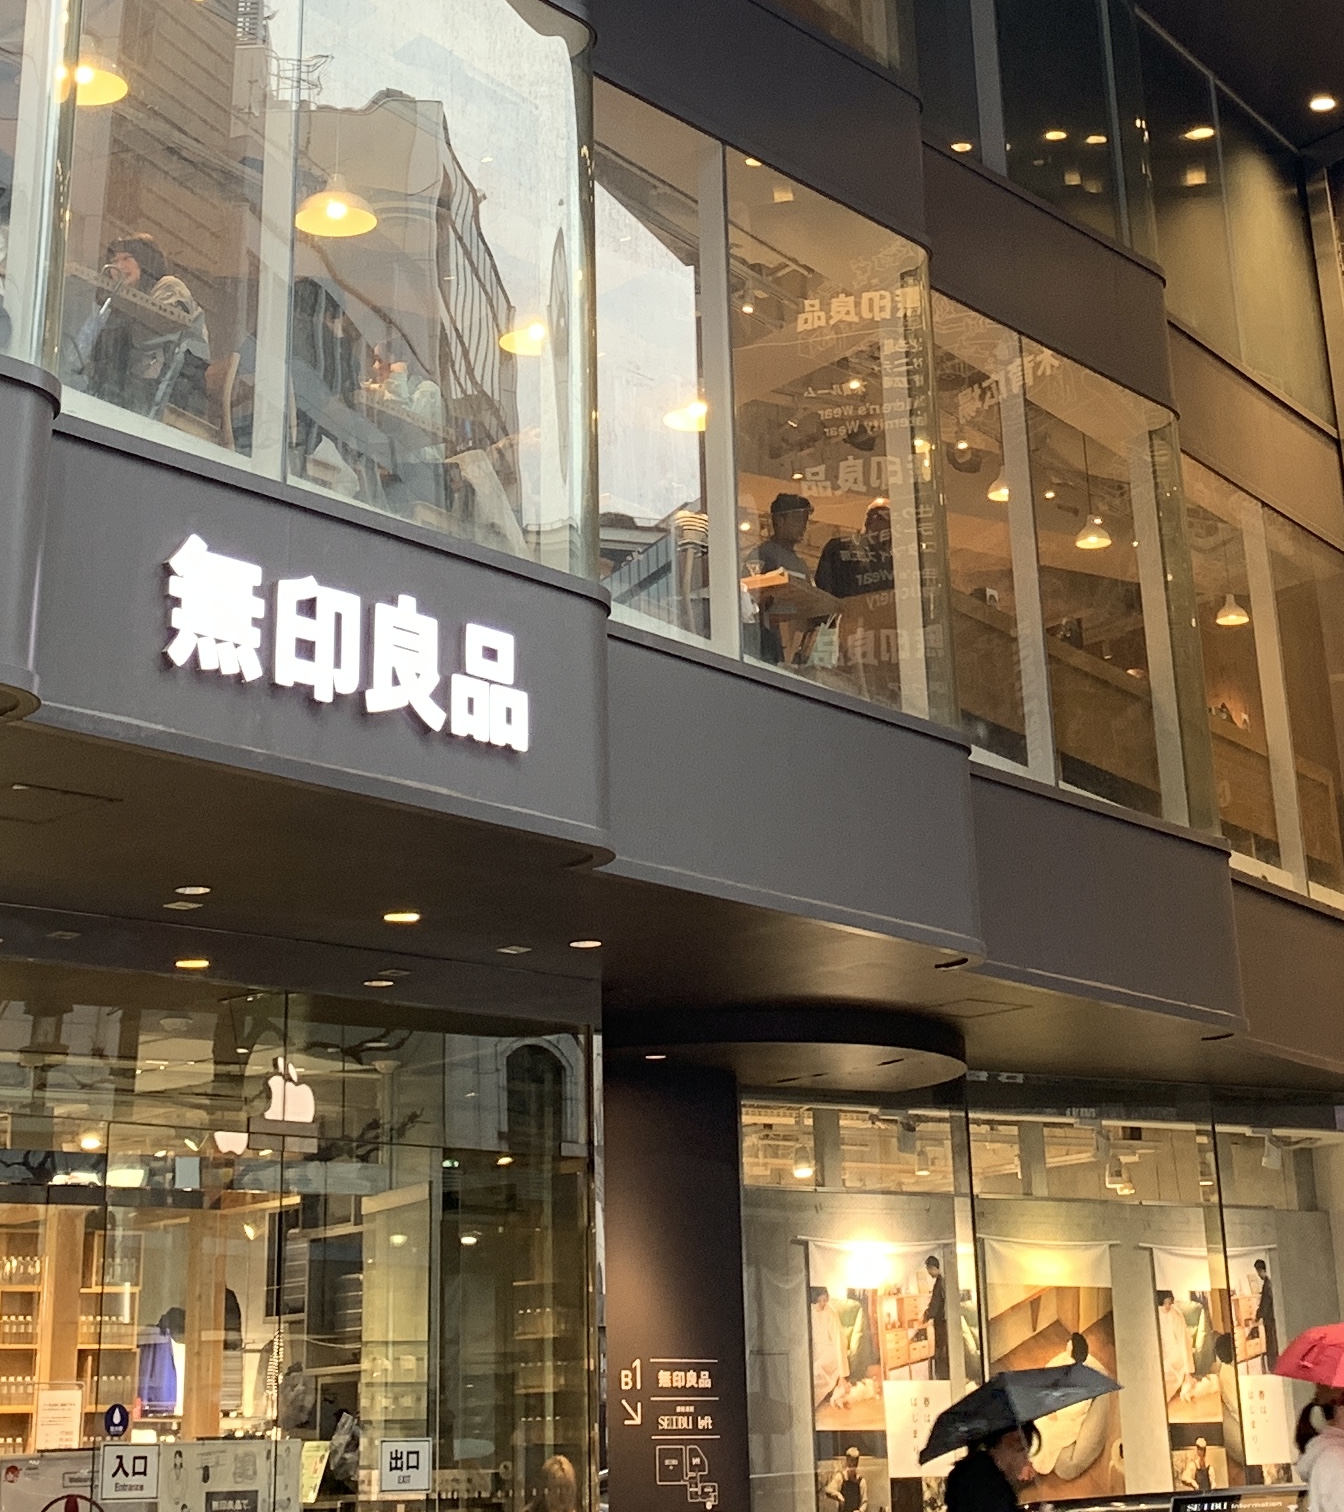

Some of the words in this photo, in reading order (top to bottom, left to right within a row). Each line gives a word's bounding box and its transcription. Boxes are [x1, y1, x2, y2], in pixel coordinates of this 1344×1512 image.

[163, 533, 529, 752] 無印良品
[621, 1359, 641, 1390] B1
[657, 1369, 712, 1388] 無印良品
[658, 1416, 692, 1429] SEIBU
[112, 1455, 148, 1478] 入口
[389, 1449, 420, 1472] 出口
[114, 1482, 144, 1493] Entrance
[397, 1475, 411, 1484] EXIT
